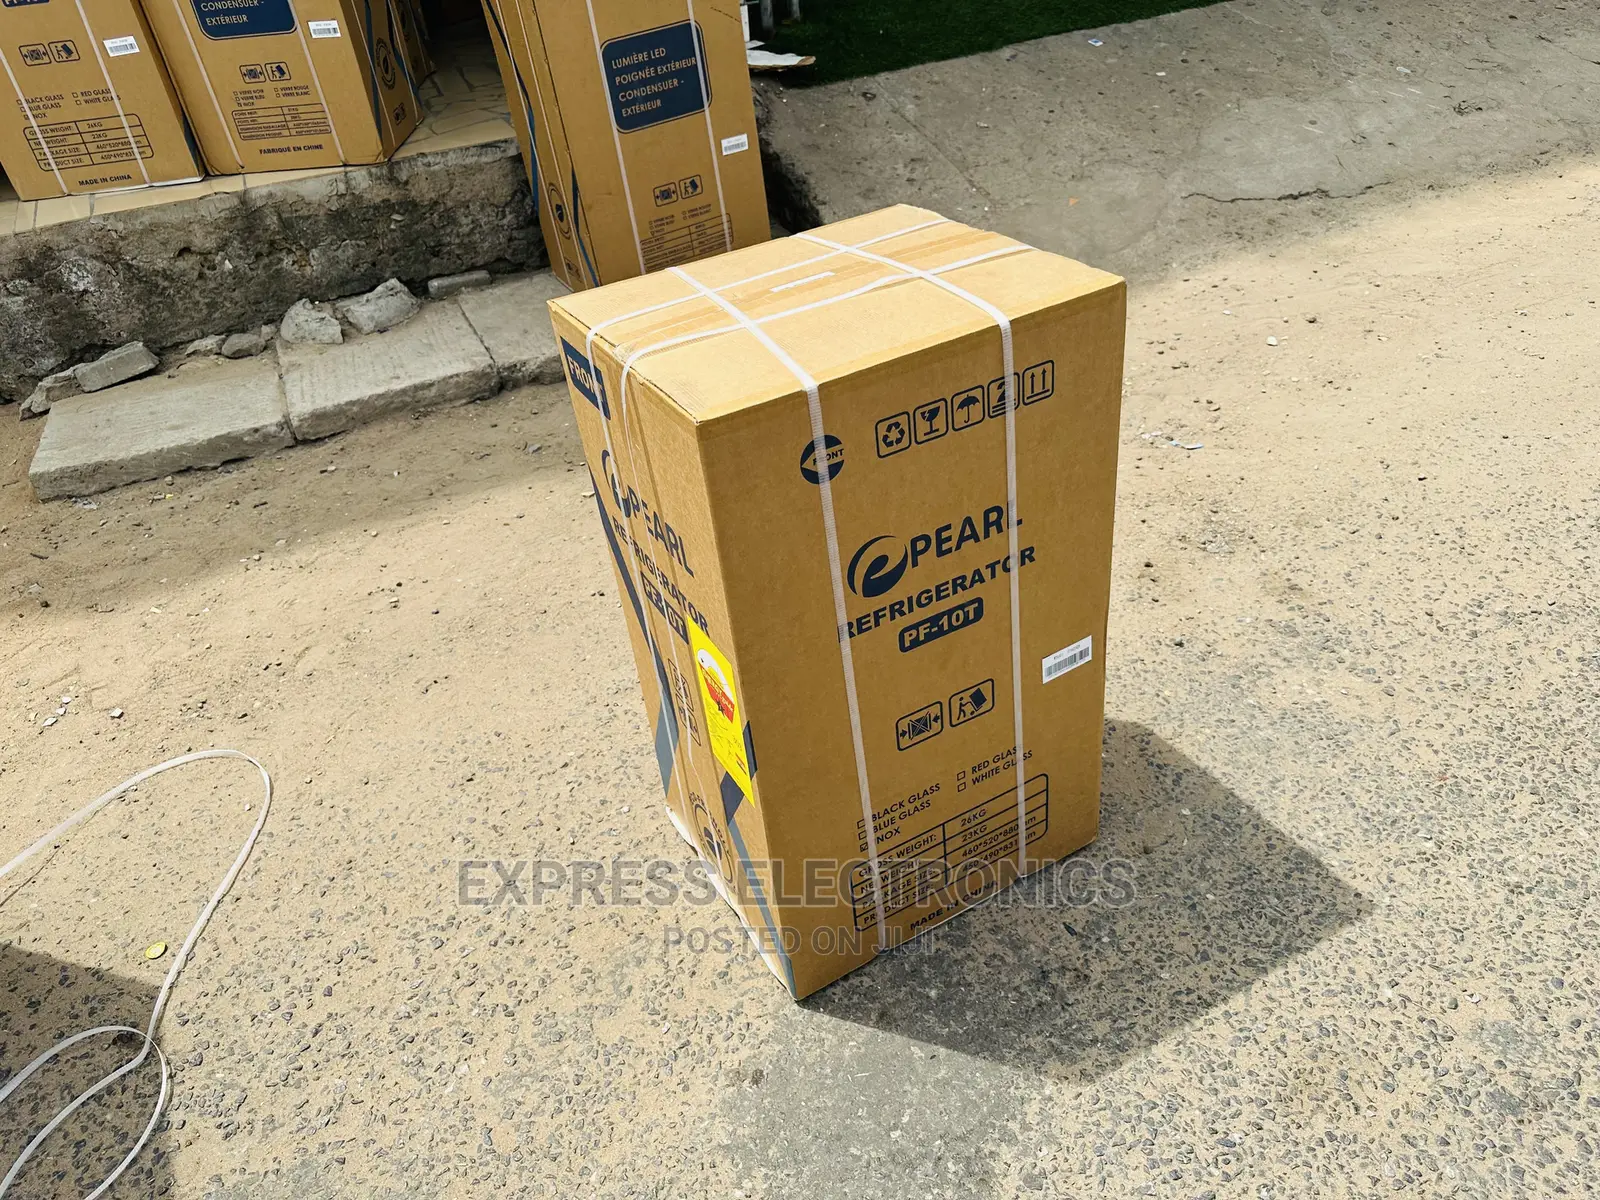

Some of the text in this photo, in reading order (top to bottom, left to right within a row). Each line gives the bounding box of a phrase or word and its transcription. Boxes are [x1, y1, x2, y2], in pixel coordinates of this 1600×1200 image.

[200, 0, 259, 11] CONDENSUER
[205, 14, 249, 26] EXTÉRIEUR
[611, 47, 666, 69] LUMIÈRE LED
[615, 57, 697, 85] POIGNÉE EXTÉRIEUR
[45, 94, 64, 102] GLASS
[618, 78, 679, 101] CONDENSUER
[42, 102, 62, 110] GLASS
[621, 98, 662, 117] EXTÉRIEUR
[259, 147, 292, 155] FABRIQUÉ
[109, 174, 132, 182] CHINA
[812, 448, 844, 466] FONT
[627, 485, 694, 578] PEARL
[910, 501, 1023, 569] PEARL
[837, 546, 1036, 643] REFRIGERATOR
[903, 602, 979, 648] PF-10T
[971, 746, 1018, 775] RED GLAS
[972, 750, 1033, 786] WHITE GLSS
[871, 783, 941, 822] BLACK GLASS
[873, 799, 932, 833] BLUE GLASS
[960, 808, 987, 827] 26KG
[876, 827, 901, 845] NOX
[961, 824, 987, 843] 23KG
[896, 834, 937, 859] WEIGHT:
[862, 879, 912, 909] PAKAGE
[910, 908, 943, 930] MADE
